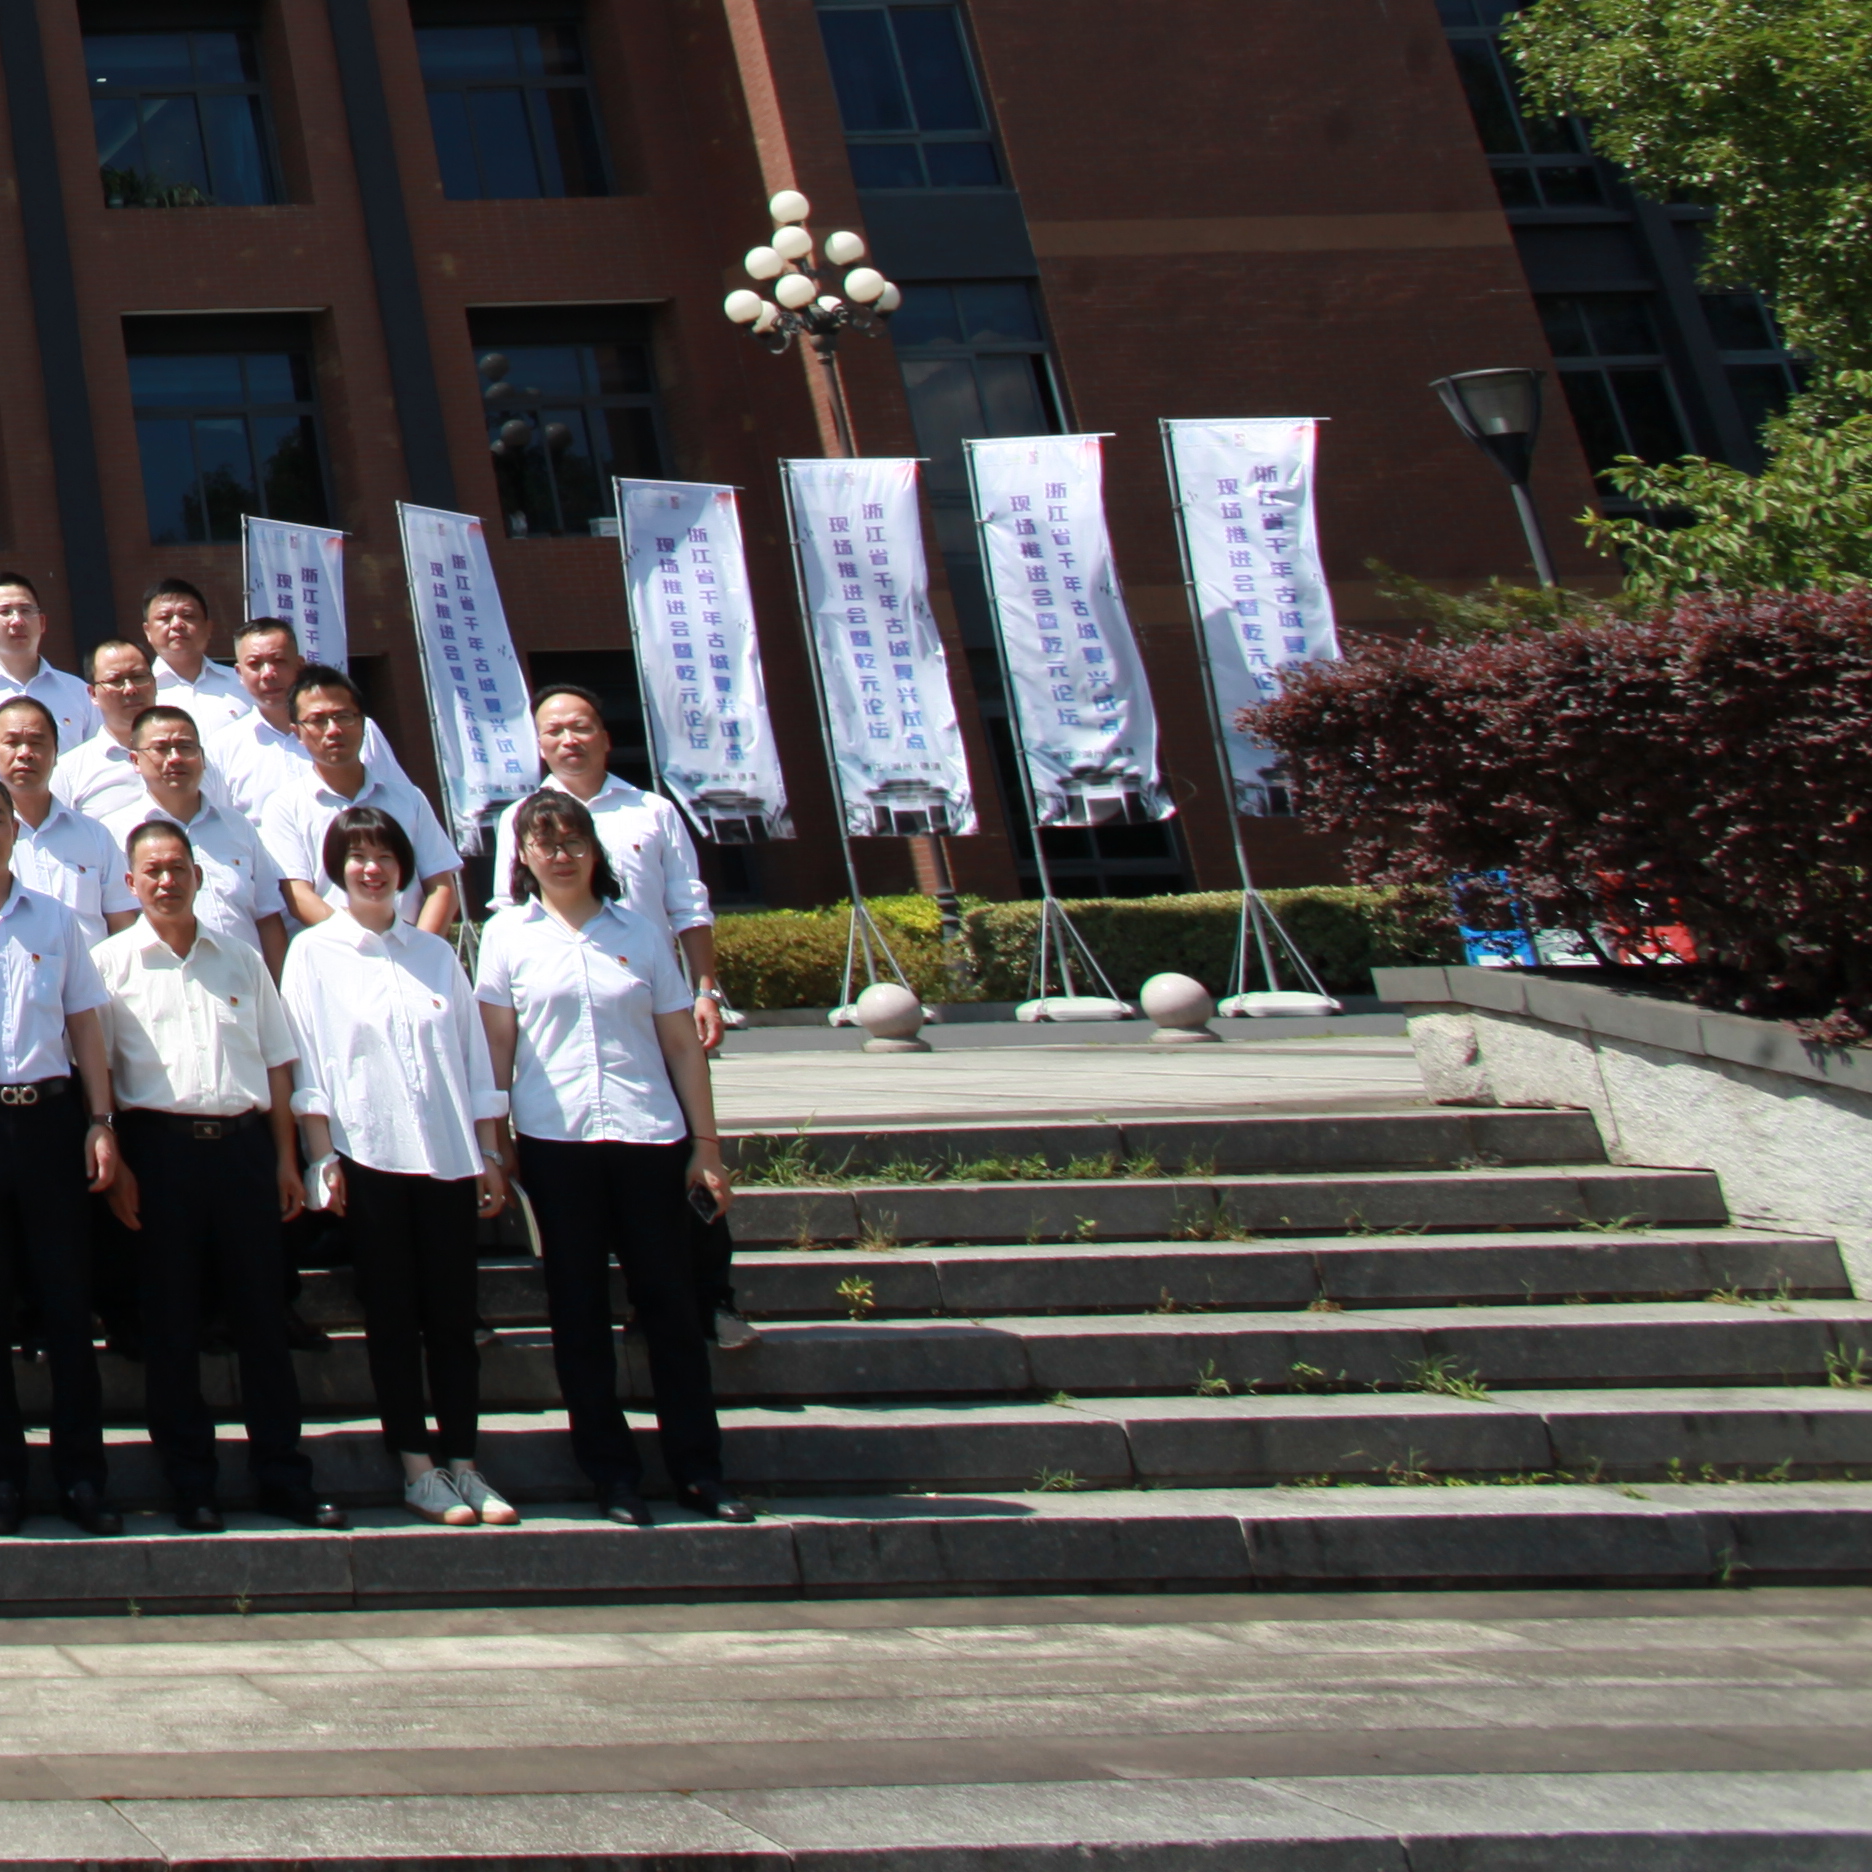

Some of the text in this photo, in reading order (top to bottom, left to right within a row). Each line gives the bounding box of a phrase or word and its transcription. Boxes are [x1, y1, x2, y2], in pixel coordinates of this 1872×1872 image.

[1217, 478, 1276, 704] 现场推进会暨乾元论
